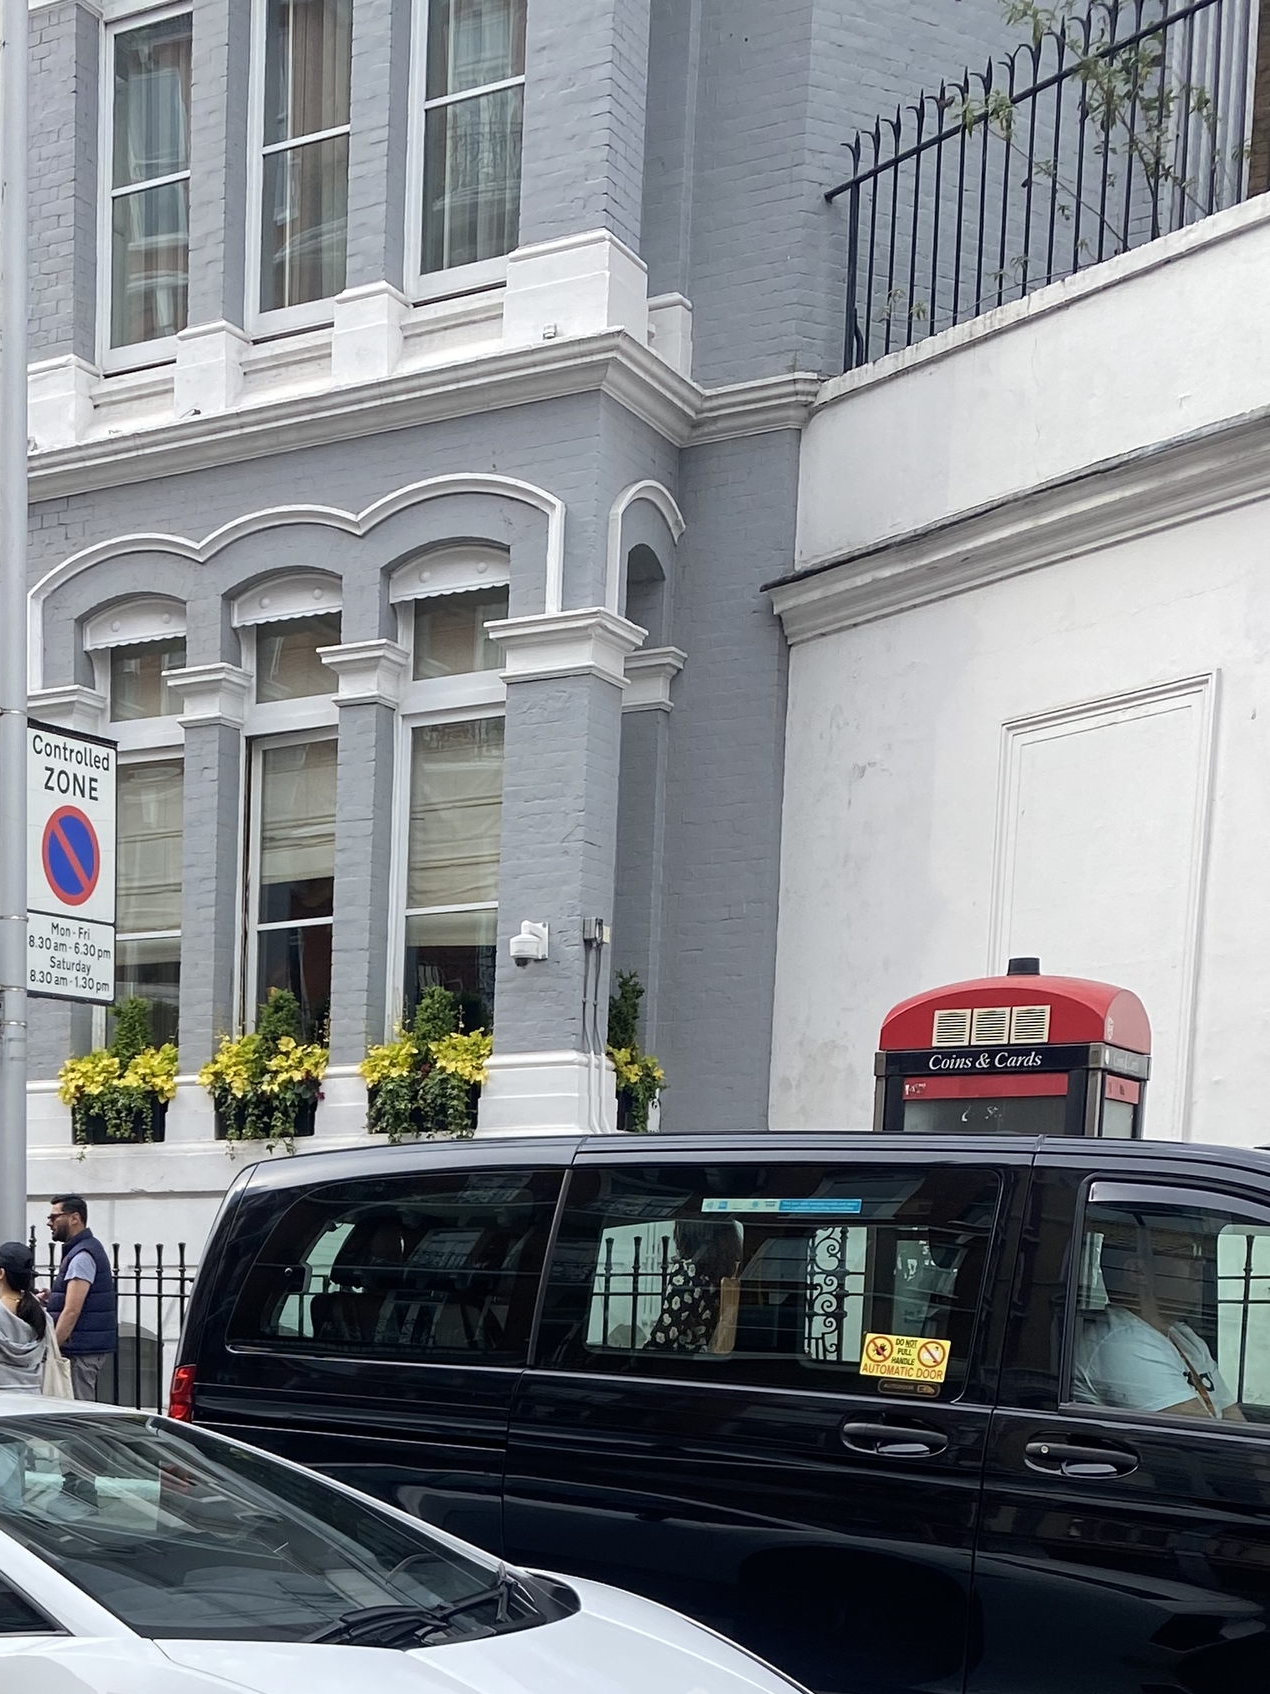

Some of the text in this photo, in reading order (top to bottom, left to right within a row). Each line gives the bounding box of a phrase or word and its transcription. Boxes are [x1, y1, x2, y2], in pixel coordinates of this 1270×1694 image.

[32, 734, 110, 772] Controlled
[44, 766, 99, 802] ZONE
[51, 922, 71, 938] Mon
[78, 927, 91, 941] Fri
[28, 935, 52, 950] 8.30
[53, 941, 67, 953] am
[74, 942, 96, 957] 6.30
[97, 948, 111, 961] pm
[49, 955, 92, 977] Saturday
[29, 969, 53, 985] 8.30
[54, 976, 68, 987] am
[74, 975, 95, 991] 1.30
[96, 982, 110, 994] pm
[928, 1051, 1042, 1071] Coins & Cards
[895, 1338, 918, 1348] DO NOT
[897, 1348, 912, 1357] PULL
[891, 1356, 916, 1366] HANDLE
[862, 1362, 944, 1381] AUTOMATIC DOOR
